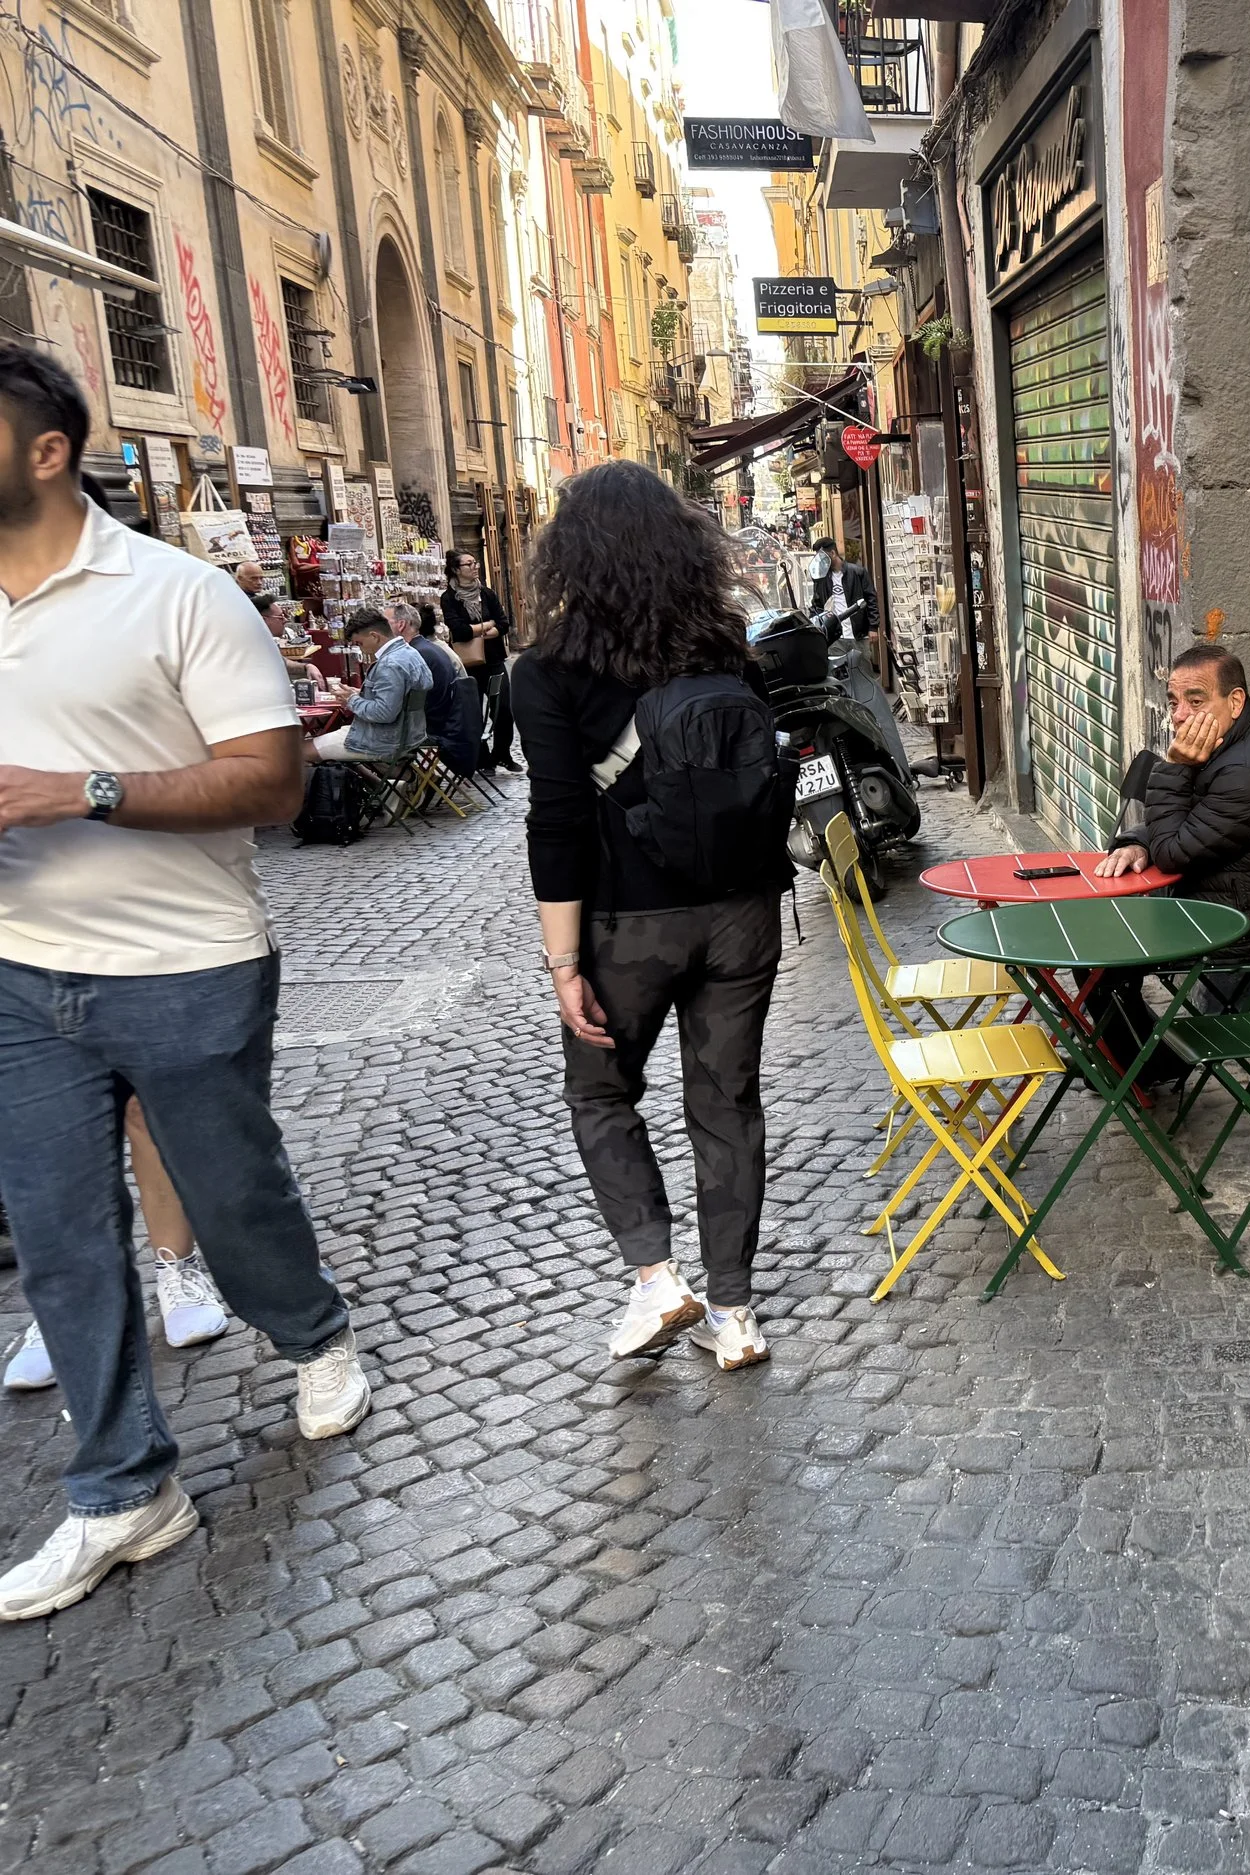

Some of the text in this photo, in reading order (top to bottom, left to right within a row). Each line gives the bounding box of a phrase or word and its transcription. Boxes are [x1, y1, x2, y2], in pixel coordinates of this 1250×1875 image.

[709, 142, 788, 151] CASAVACANZA
[760, 283, 828, 295] Pizzeria e
[759, 302, 832, 317] Friggitoria
[799, 761, 826, 779] RSA
